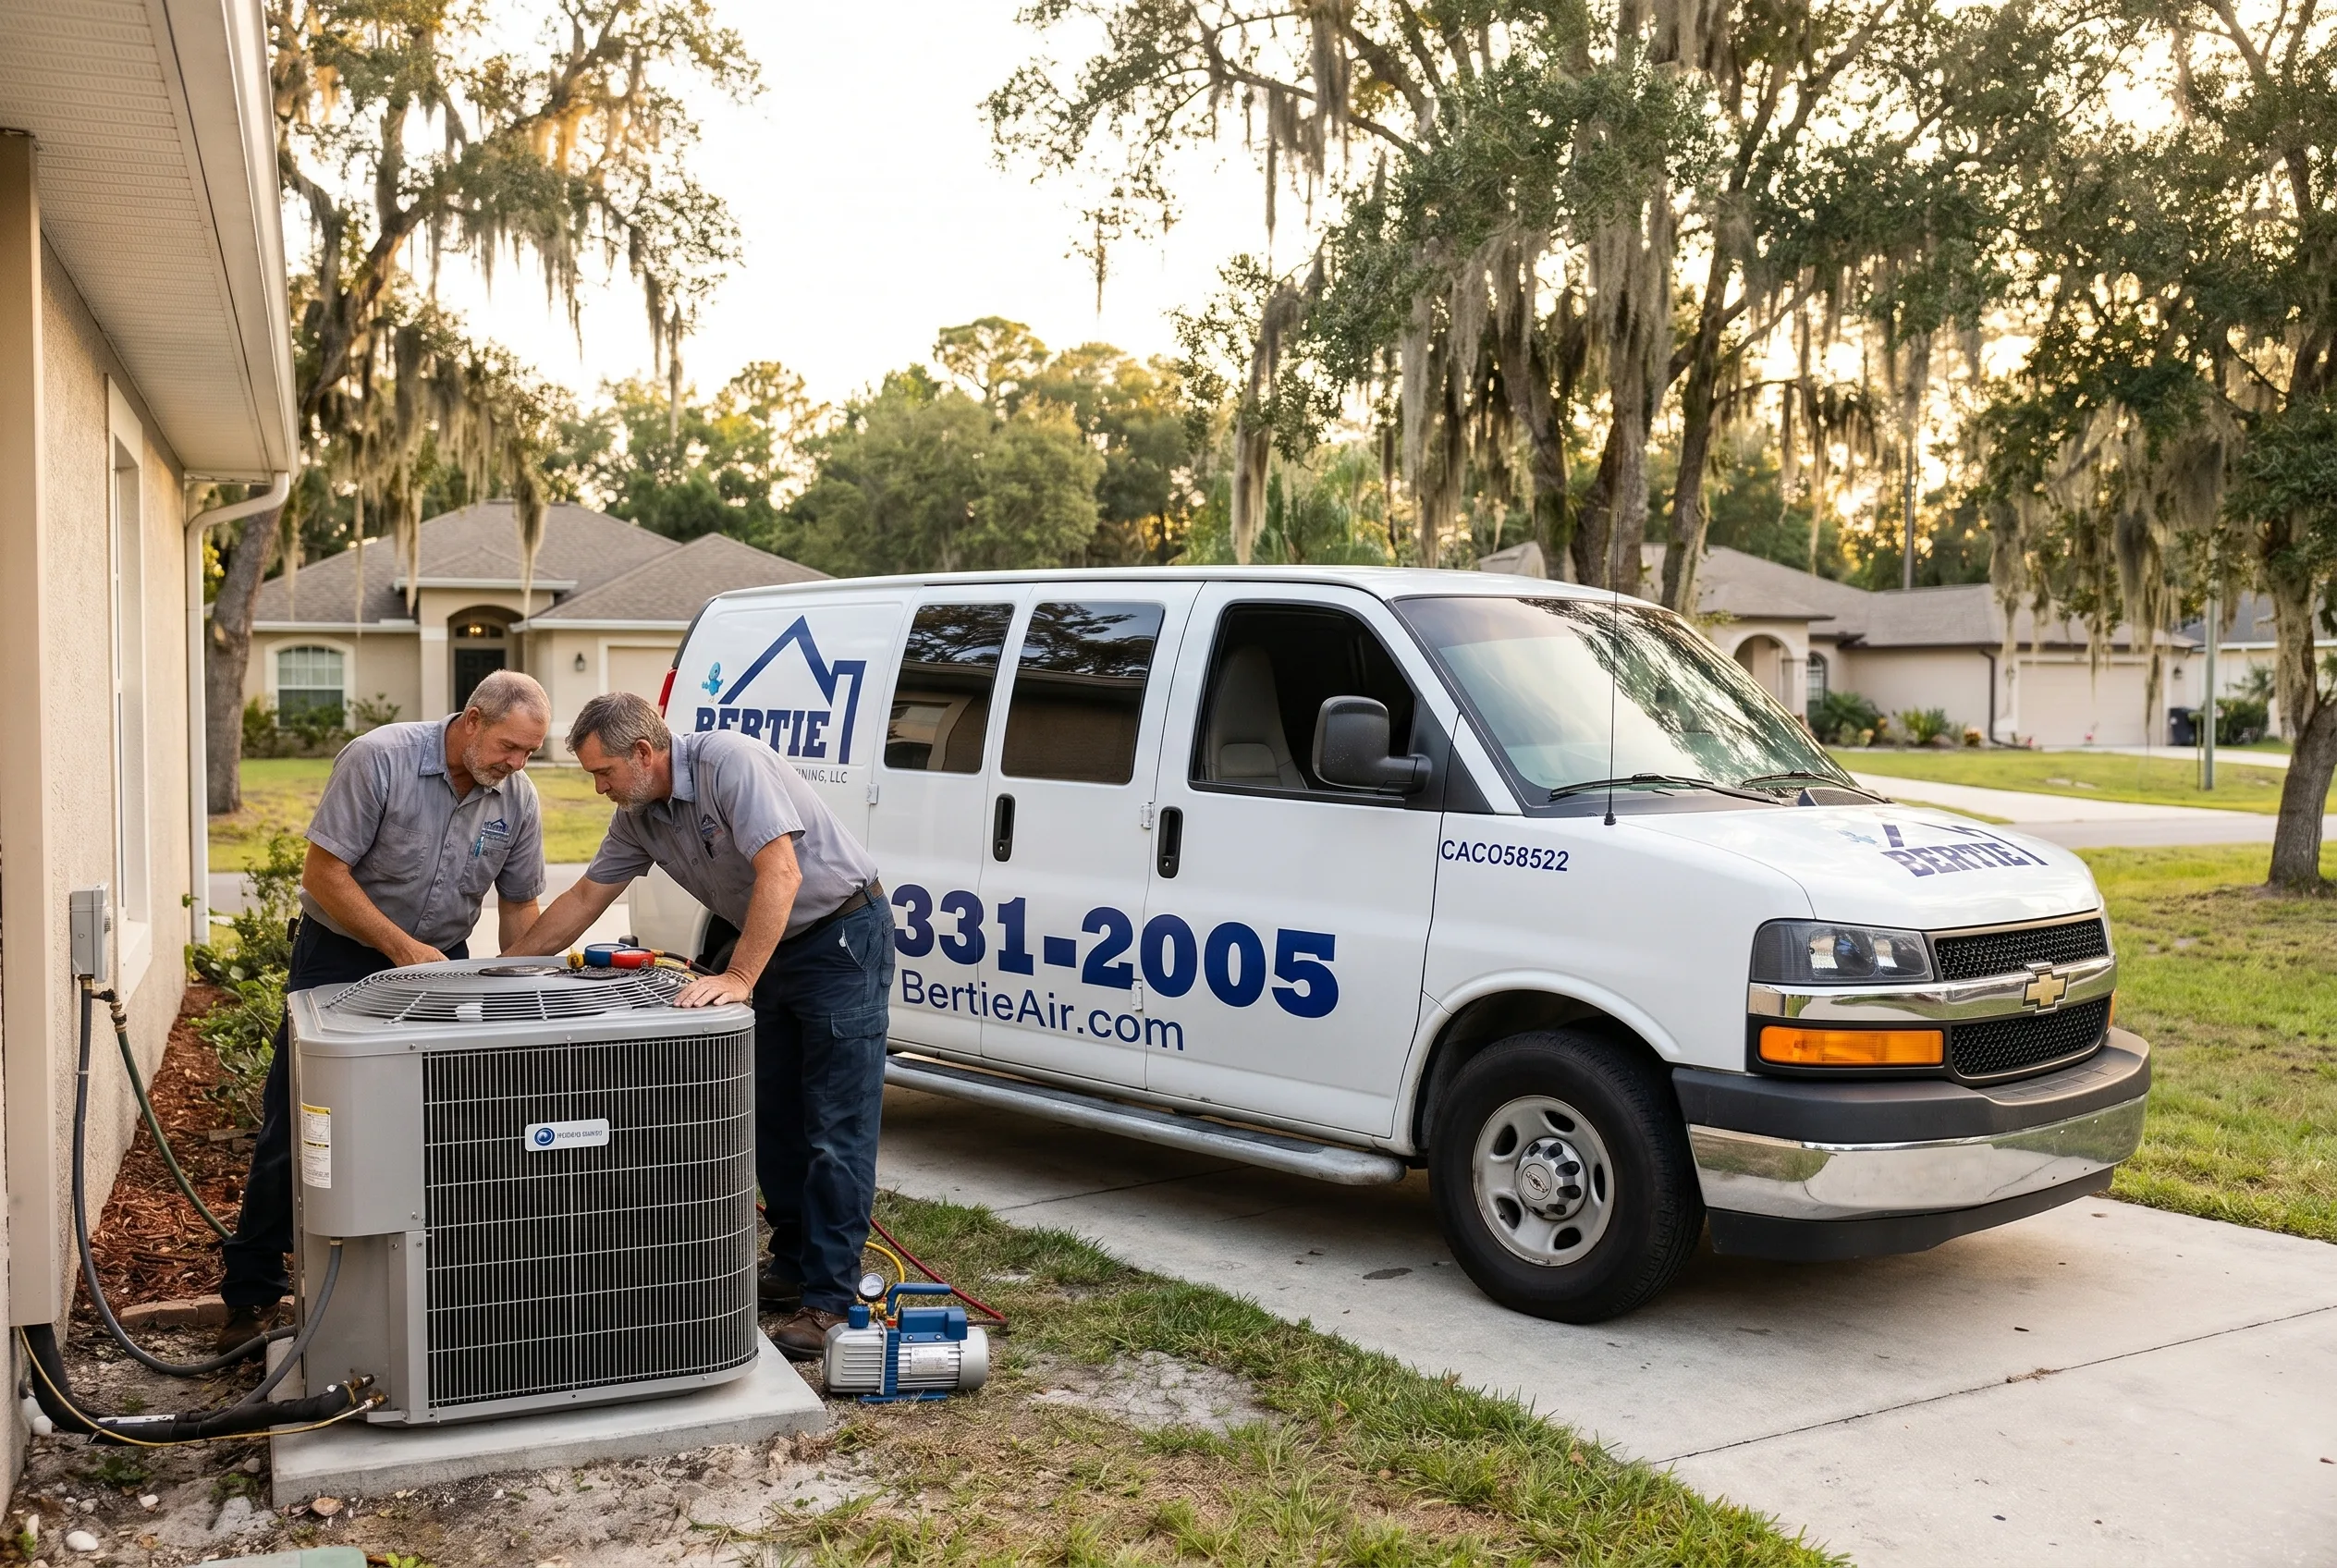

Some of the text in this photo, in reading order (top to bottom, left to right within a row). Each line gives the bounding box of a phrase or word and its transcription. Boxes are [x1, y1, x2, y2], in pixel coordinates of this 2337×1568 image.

[830, 770, 848, 784] LLC
[1880, 842, 2032, 877] BERTIE
[891, 884, 1340, 1018] 331-2005
[901, 968, 1184, 1051] BertieAir.com
